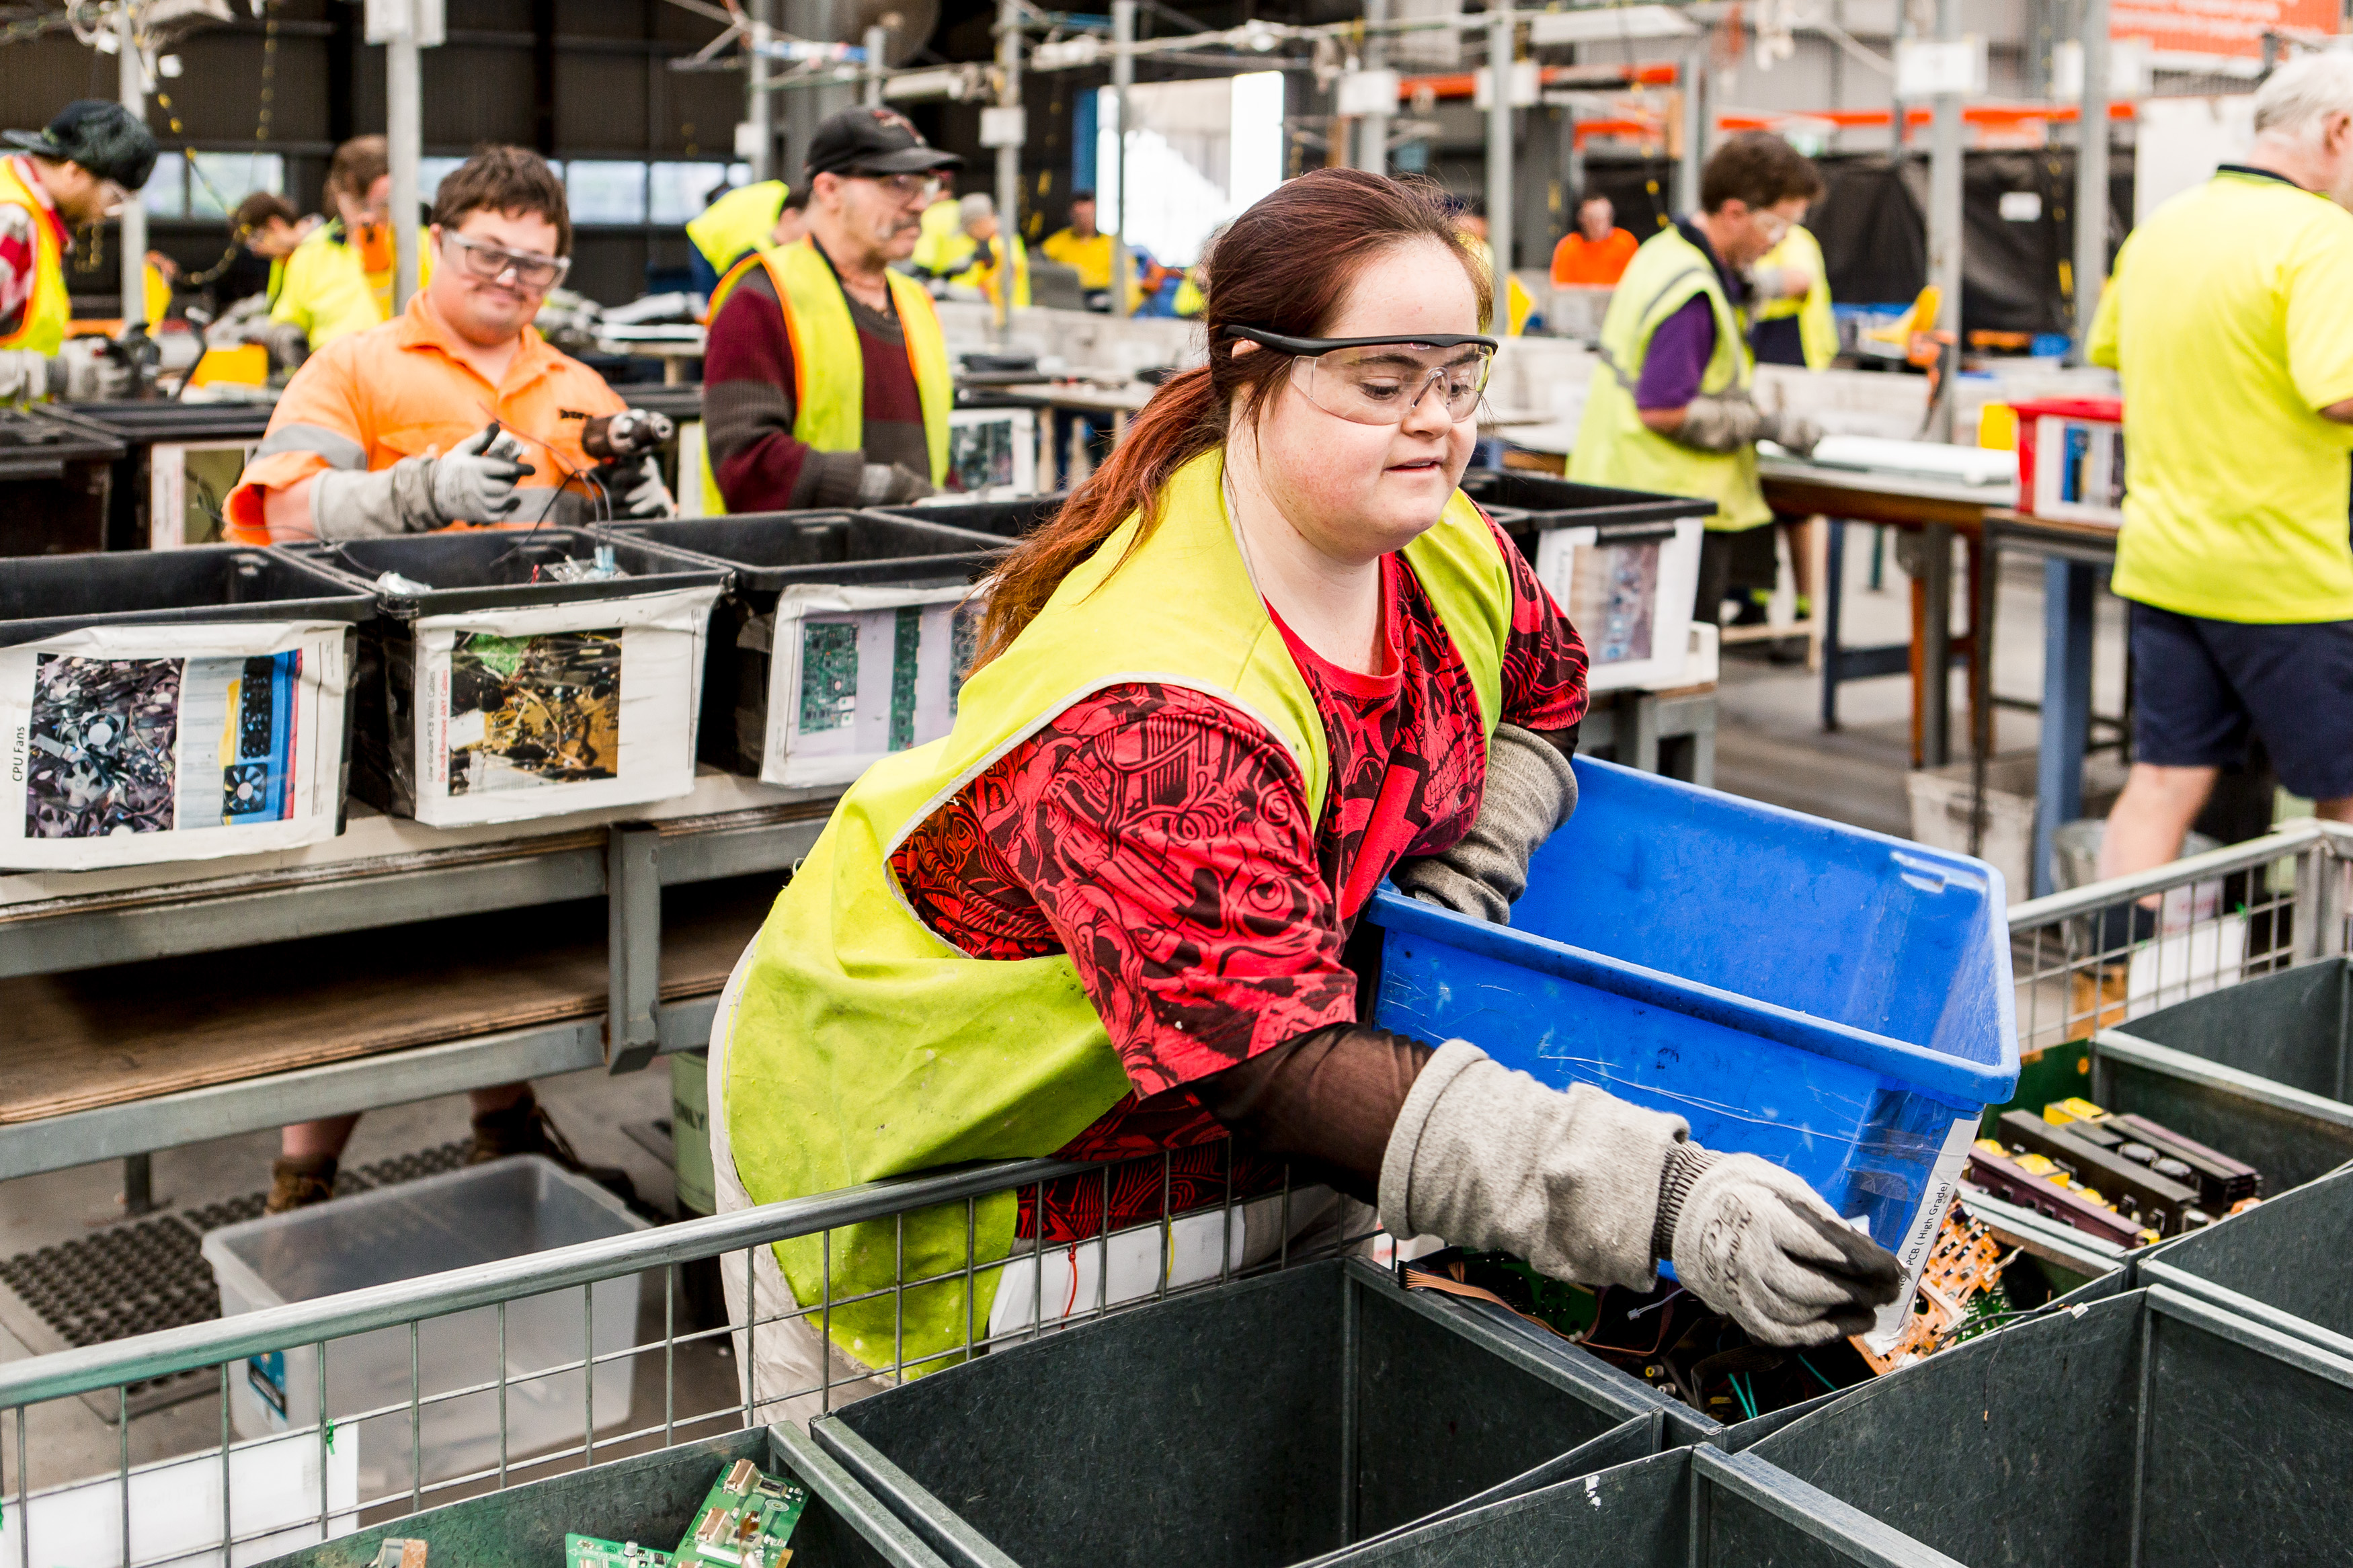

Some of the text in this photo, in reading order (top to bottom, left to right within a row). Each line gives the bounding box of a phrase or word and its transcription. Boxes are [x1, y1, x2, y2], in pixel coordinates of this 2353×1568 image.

[12, 726, 25, 782] CPU Fans
[439, 719, 447, 753] Remove
[438, 771, 446, 782] Do
[1906, 1248, 1920, 1265] PCB
[1917, 1218, 1934, 1239] High
[1929, 1182, 1951, 1216] Grade)
